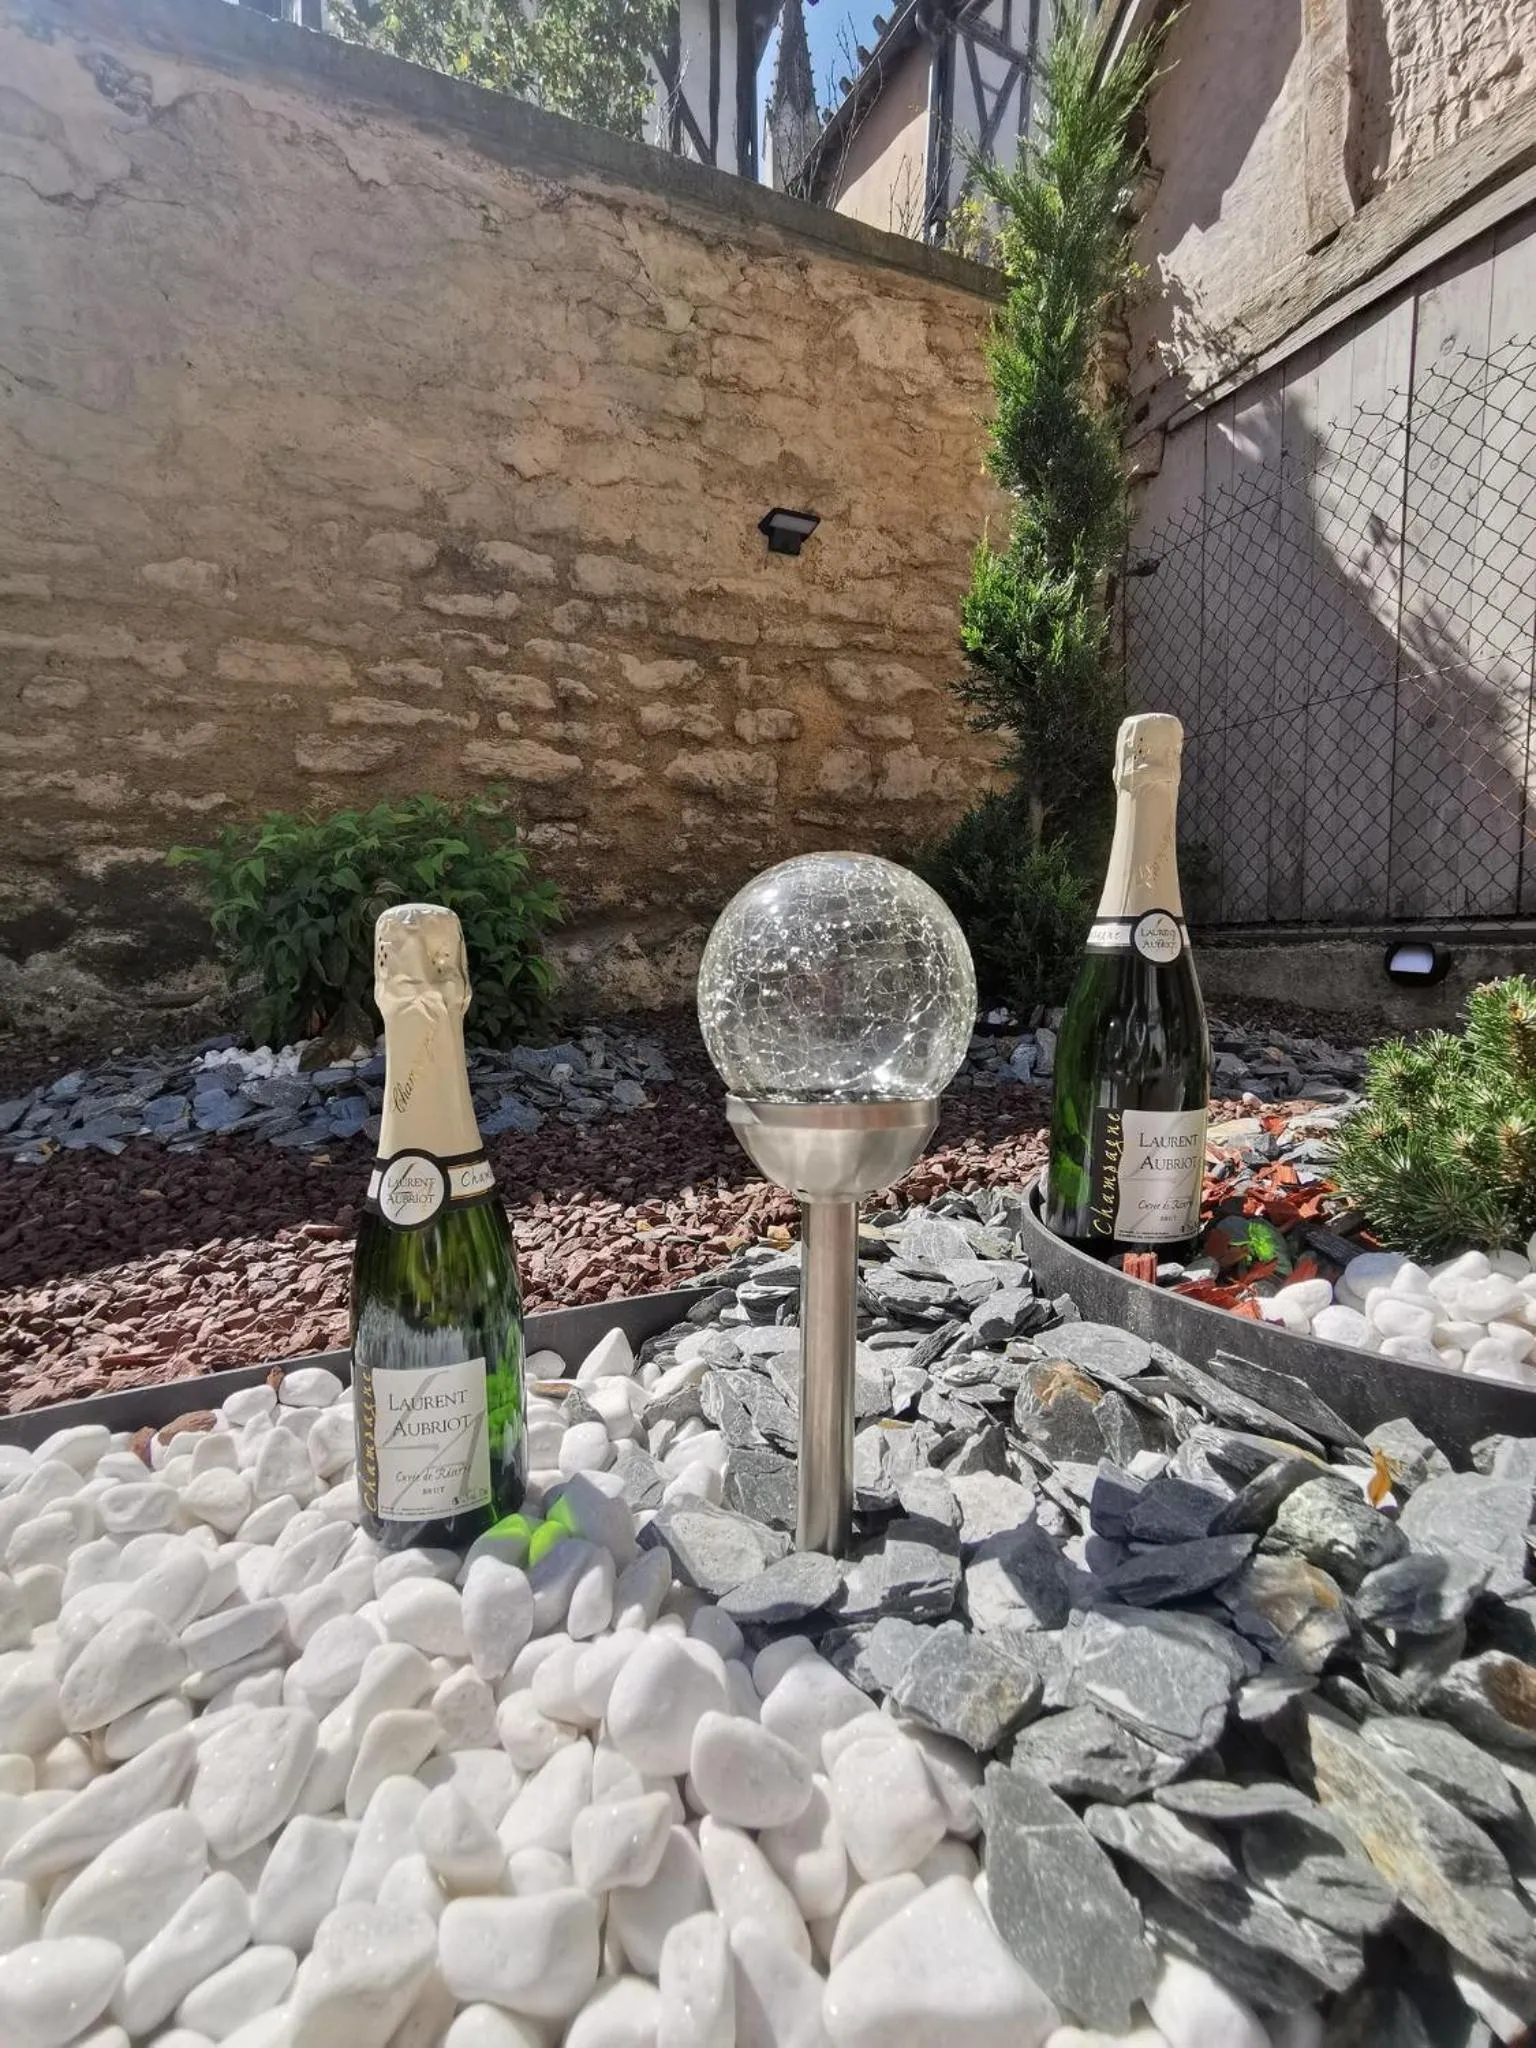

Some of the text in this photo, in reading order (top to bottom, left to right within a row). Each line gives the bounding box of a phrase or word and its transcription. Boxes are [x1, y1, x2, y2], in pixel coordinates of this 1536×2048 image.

[1139, 1132, 1199, 1148] LAURENT
[1140, 1155, 1199, 1171] AUBRIOT
[388, 1177, 436, 1189] LAURENT
[388, 1389, 469, 1412] LAURENT
[391, 1413, 473, 1438] AUBRIOT
